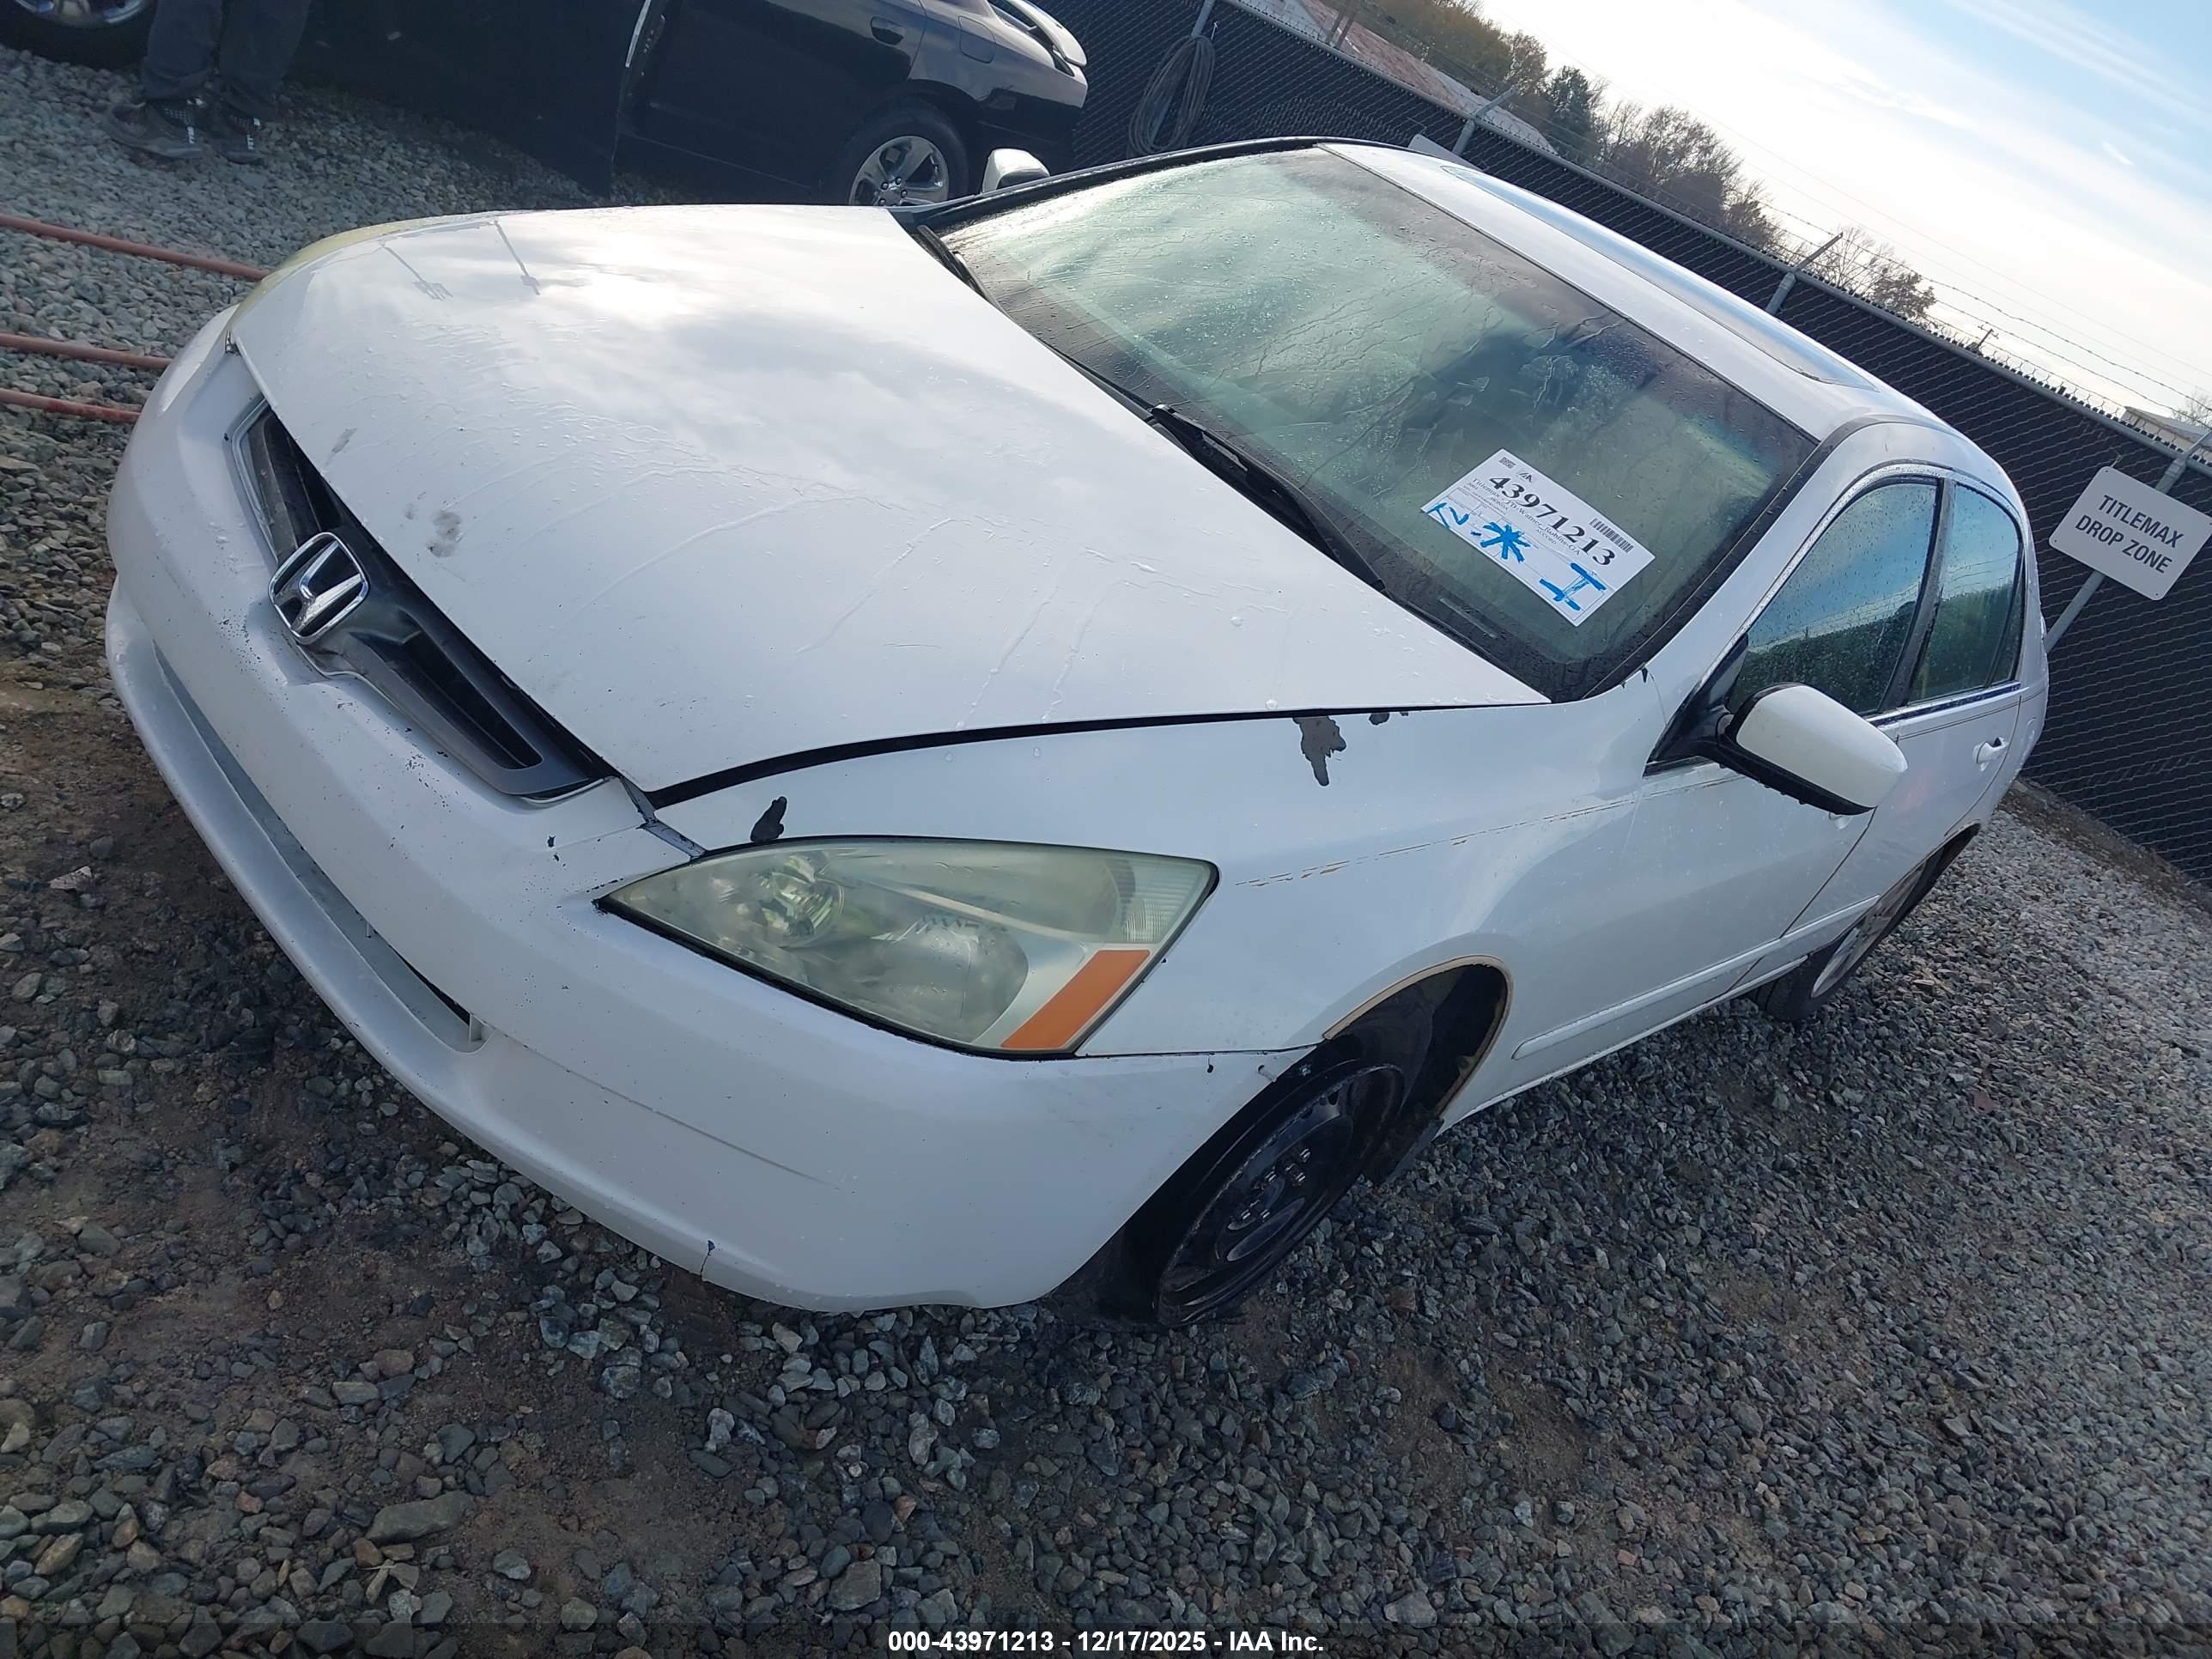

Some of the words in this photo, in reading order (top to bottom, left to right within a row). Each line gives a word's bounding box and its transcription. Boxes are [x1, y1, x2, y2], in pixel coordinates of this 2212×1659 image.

[1489, 478, 1615, 566] 43971213
[2075, 515, 2124, 546] DROP
[2123, 539, 2173, 573] ZONE
[2098, 495, 2185, 548] TITLEMAX
